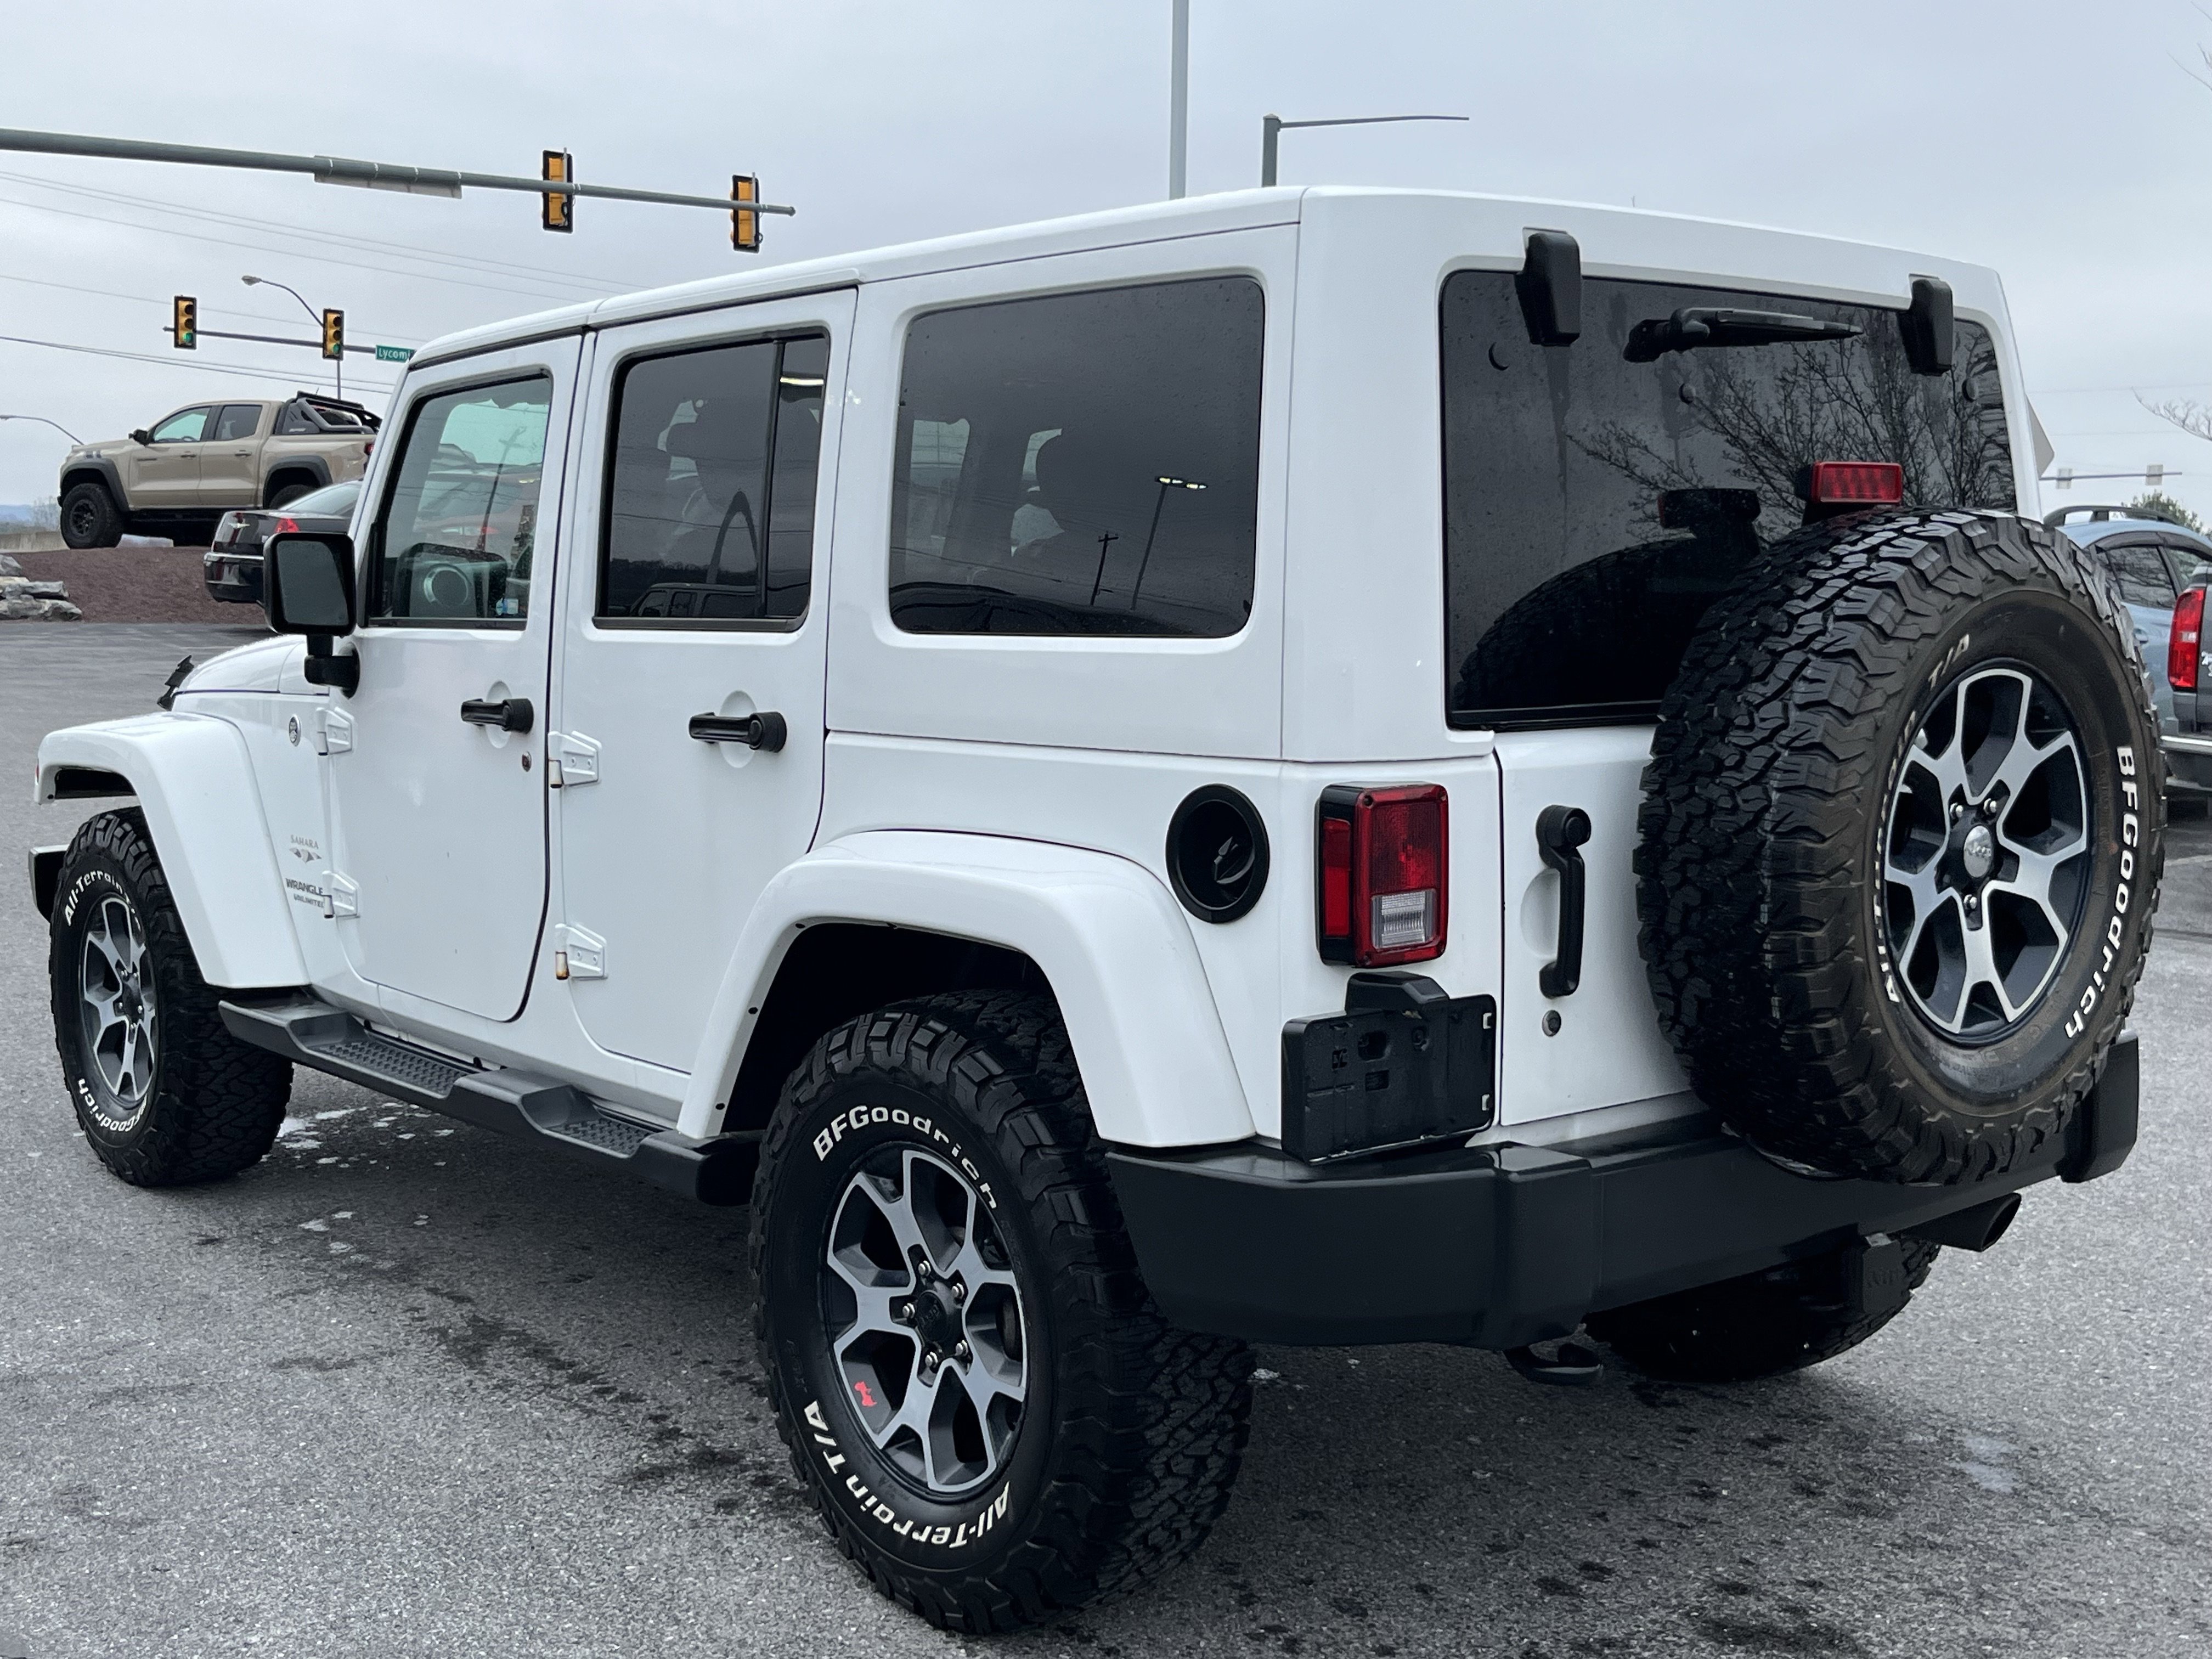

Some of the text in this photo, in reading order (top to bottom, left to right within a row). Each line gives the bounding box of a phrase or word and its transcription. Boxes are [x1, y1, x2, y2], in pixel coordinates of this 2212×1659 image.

[379, 348, 410, 359] Lycomi
[1927, 633, 1970, 691] T/A
[291, 834, 319, 849] SAHARA
[65, 870, 123, 926] All-Terrain
[286, 878, 323, 894] WRANGLE
[2065, 746, 2138, 1039] BFGoodrich
[78, 1079, 148, 1132] BFGoodrich
[814, 1105, 997, 1209] BFGoodrich
[804, 1400, 845, 1474] T/A
[846, 1481, 1010, 1548] All-Terrain
